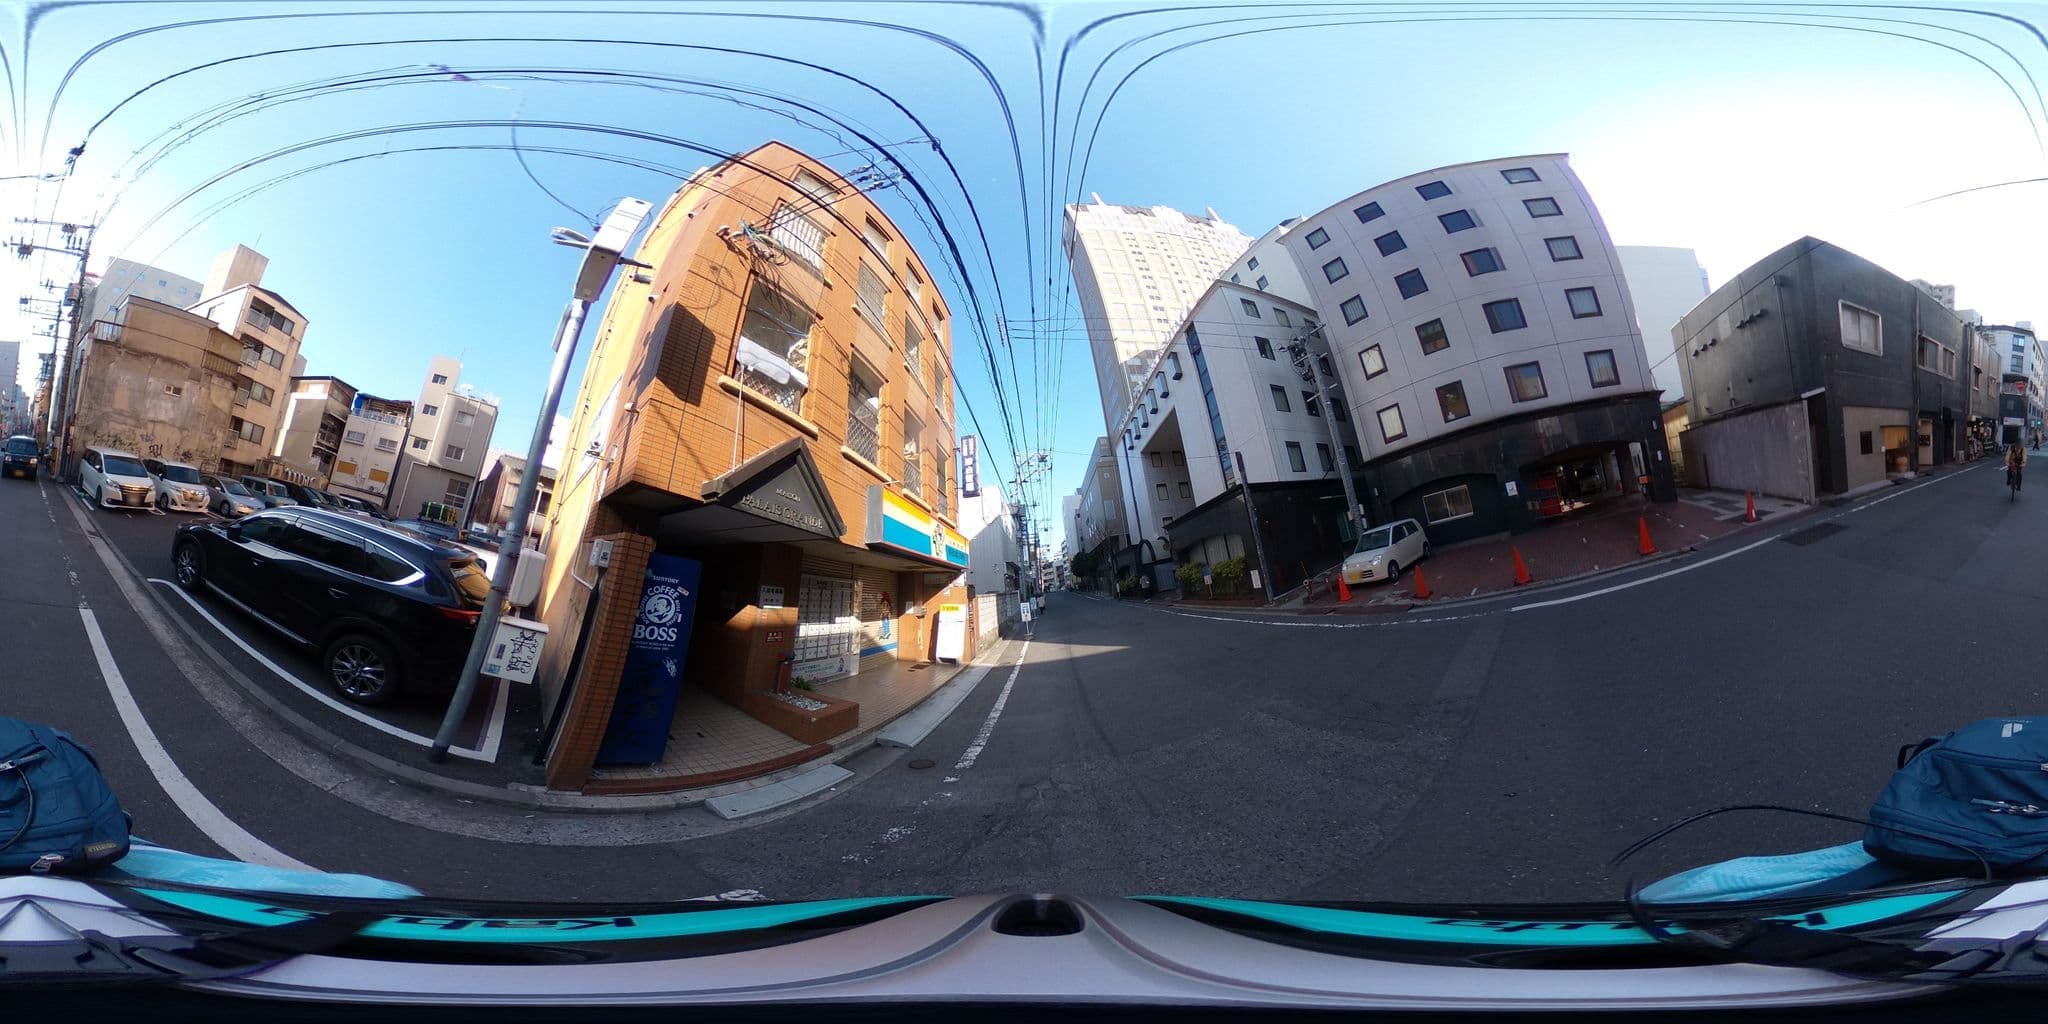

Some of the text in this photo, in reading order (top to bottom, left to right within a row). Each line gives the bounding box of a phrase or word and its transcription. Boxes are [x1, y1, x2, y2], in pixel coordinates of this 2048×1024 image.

[741, 494, 823, 529] PALAIS GRANDE
[653, 576, 679, 584] SUNTORY
[647, 585, 680, 600] COFFEE
[632, 624, 678, 642] BOSS
